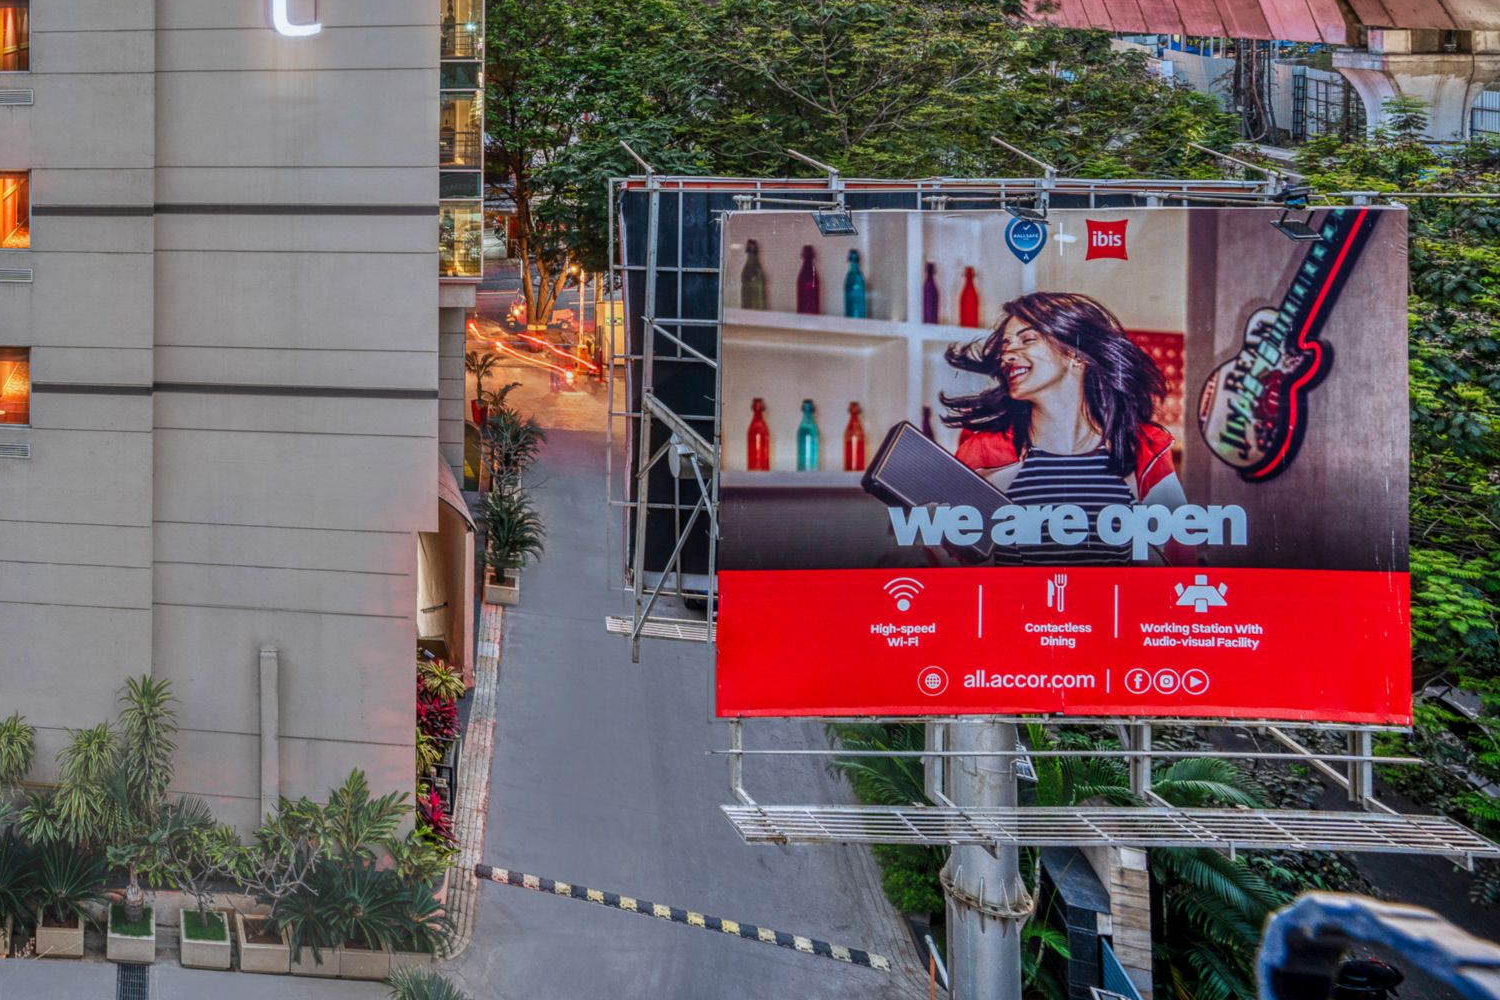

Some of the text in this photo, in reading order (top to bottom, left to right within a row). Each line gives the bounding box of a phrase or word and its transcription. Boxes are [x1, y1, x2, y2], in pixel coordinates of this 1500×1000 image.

[1092, 230, 1122, 247] ibis
[887, 504, 1248, 560] we are open
[870, 623, 936, 635] High-speed
[1024, 622, 1092, 634] Contactless
[1140, 622, 1263, 636] Working Station With
[887, 636, 919, 647] Wi-Fi
[1040, 636, 1076, 649] Dining
[1143, 636, 1260, 650] Audio-visual Facility
[963, 669, 1095, 689] all.accor.com
